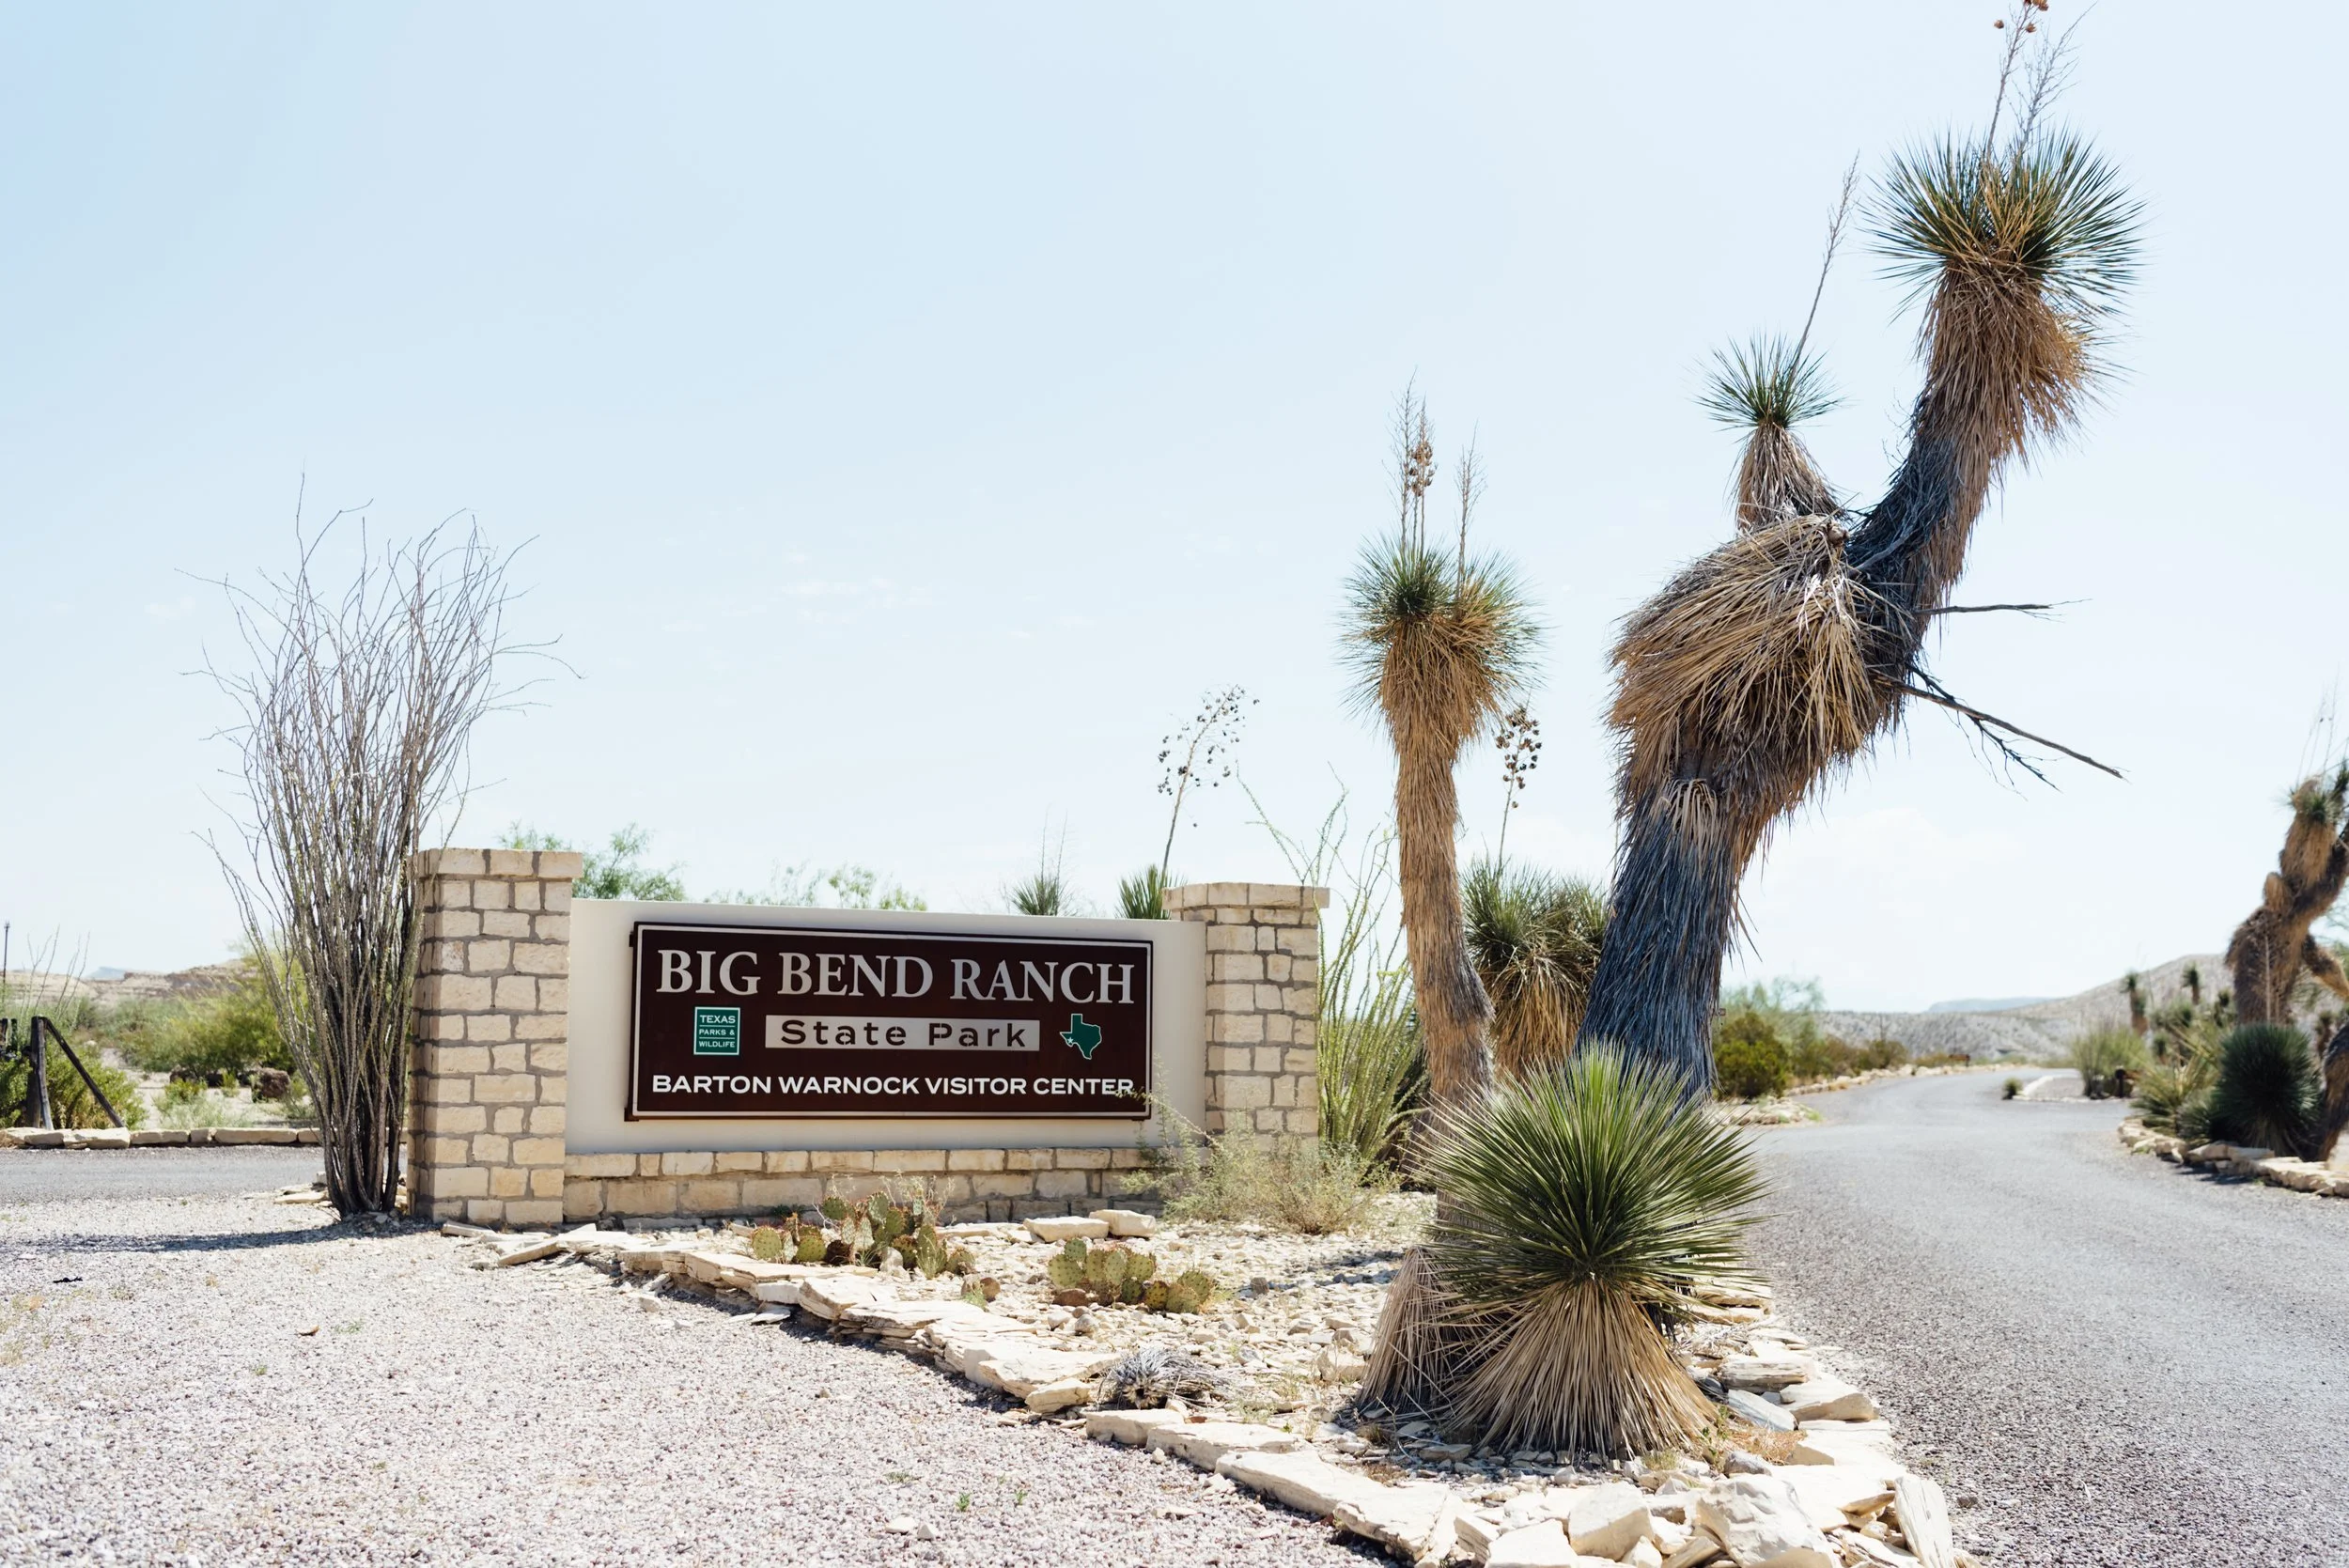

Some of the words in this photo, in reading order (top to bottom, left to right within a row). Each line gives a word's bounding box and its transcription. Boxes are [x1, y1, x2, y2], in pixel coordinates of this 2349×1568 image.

[656, 949, 761, 996] BIG
[777, 952, 934, 999] BEND
[950, 957, 1135, 1004] RANCH
[699, 1015, 736, 1024] TEXAS
[781, 1019, 907, 1046] State
[927, 1022, 1027, 1048] Park
[653, 1075, 772, 1094] BARTON
[777, 1077, 920, 1095] WARNOCK
[924, 1078, 1027, 1095] VISITOR
[1033, 1078, 1135, 1095] CENTER
